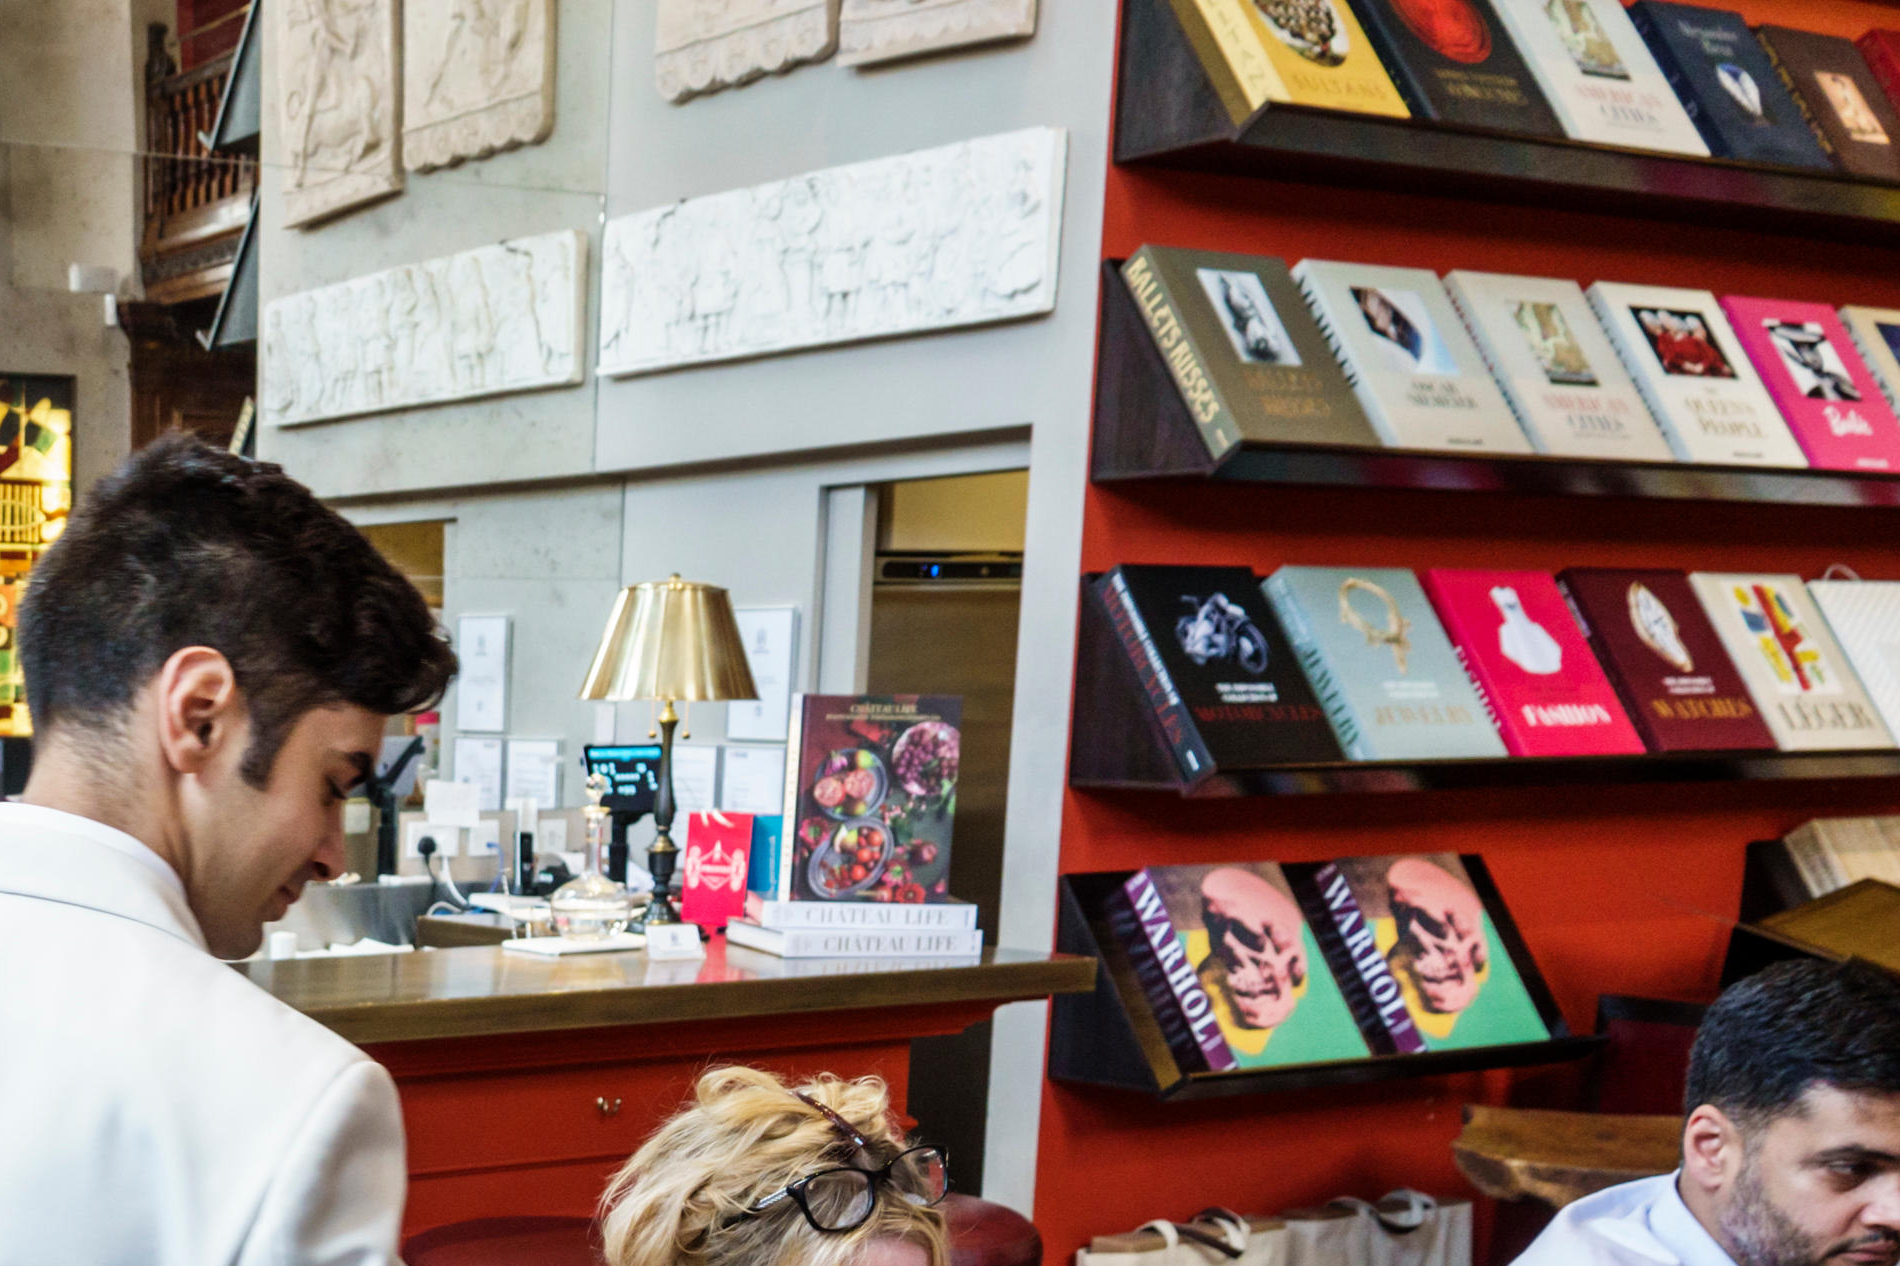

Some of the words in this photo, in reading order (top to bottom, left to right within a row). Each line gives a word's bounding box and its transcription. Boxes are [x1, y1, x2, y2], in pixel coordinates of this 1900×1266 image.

[1291, 72, 1388, 99] SULTANS
[1126, 256, 1183, 349] BALLETS
[1169, 340, 1221, 424] RUSSES
[1544, 392, 1631, 414] AMERICAN
[1822, 405, 1873, 437] Barbie
[1194, 704, 1323, 723] MOTORCYCLES
[1374, 704, 1474, 726] JEWELRY
[1520, 703, 1612, 728] FASHION
[1652, 699, 1752, 720] WATCHES
[1777, 701, 1876, 731] LÉGER
[806, 904, 895, 925] CHÂTEAU
[905, 907, 950, 925] LIFE
[823, 933, 911, 951] CHÂTEAU
[916, 935, 958, 951] LIFE
[1323, 873, 1405, 1028] WARHOL
[1135, 880, 1211, 1042] WARHOL
